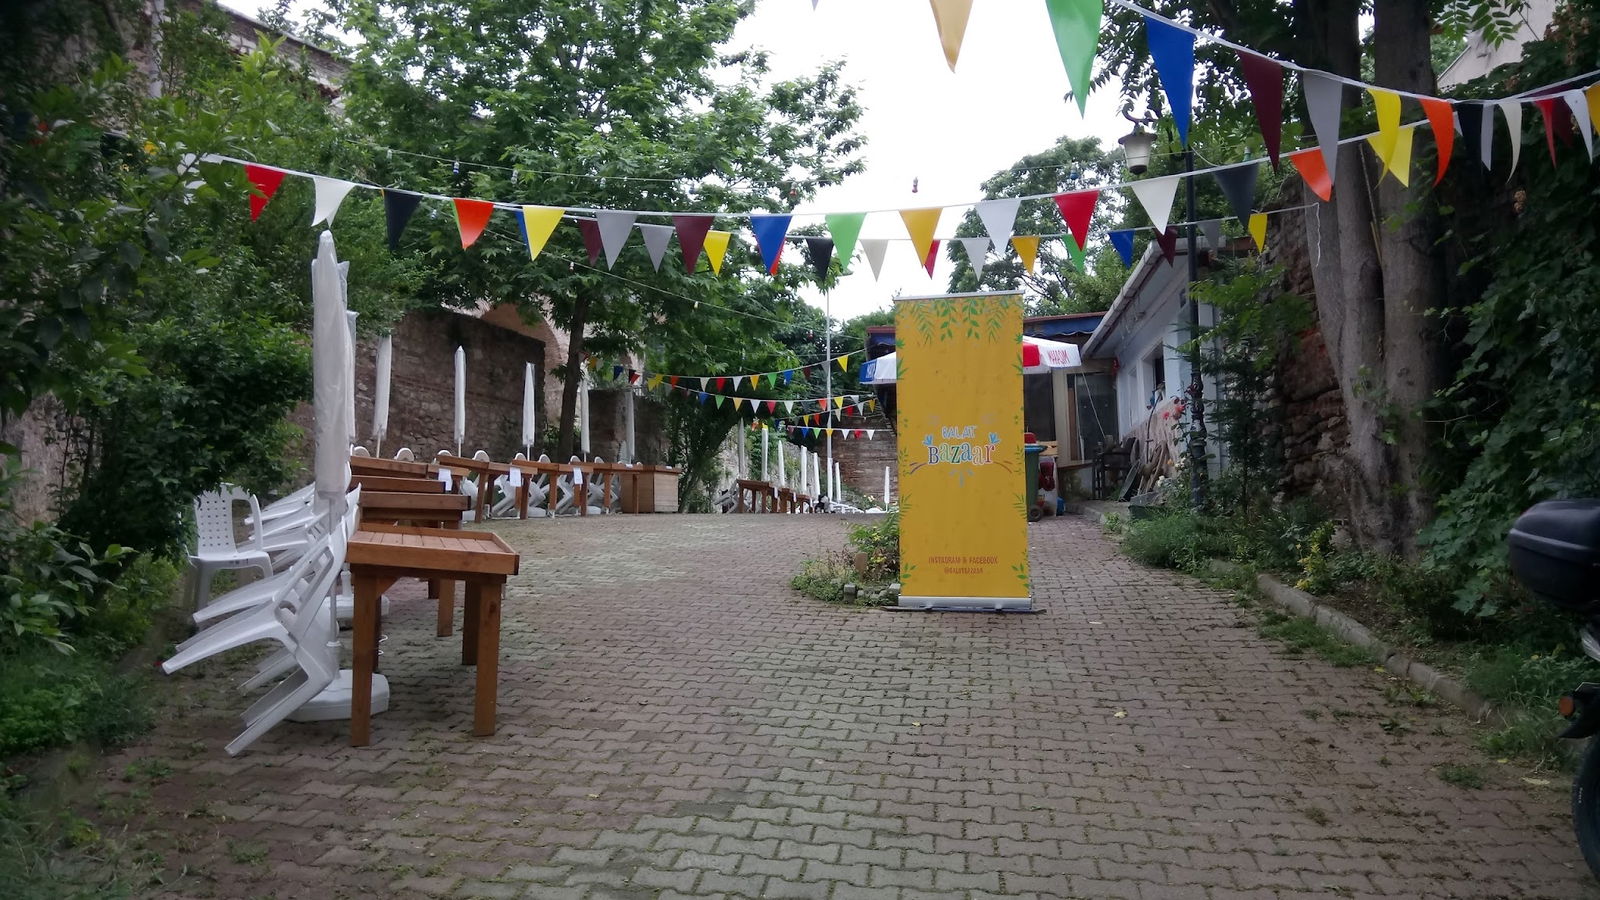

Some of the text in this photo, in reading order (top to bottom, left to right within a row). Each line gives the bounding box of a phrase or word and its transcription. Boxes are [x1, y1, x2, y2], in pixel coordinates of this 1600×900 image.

[941, 425, 977, 439] BALAT
[927, 442, 996, 465] Bazaar
[928, 556, 961, 565] INSTAGRAM
[969, 556, 998, 565] FACEBOOK
